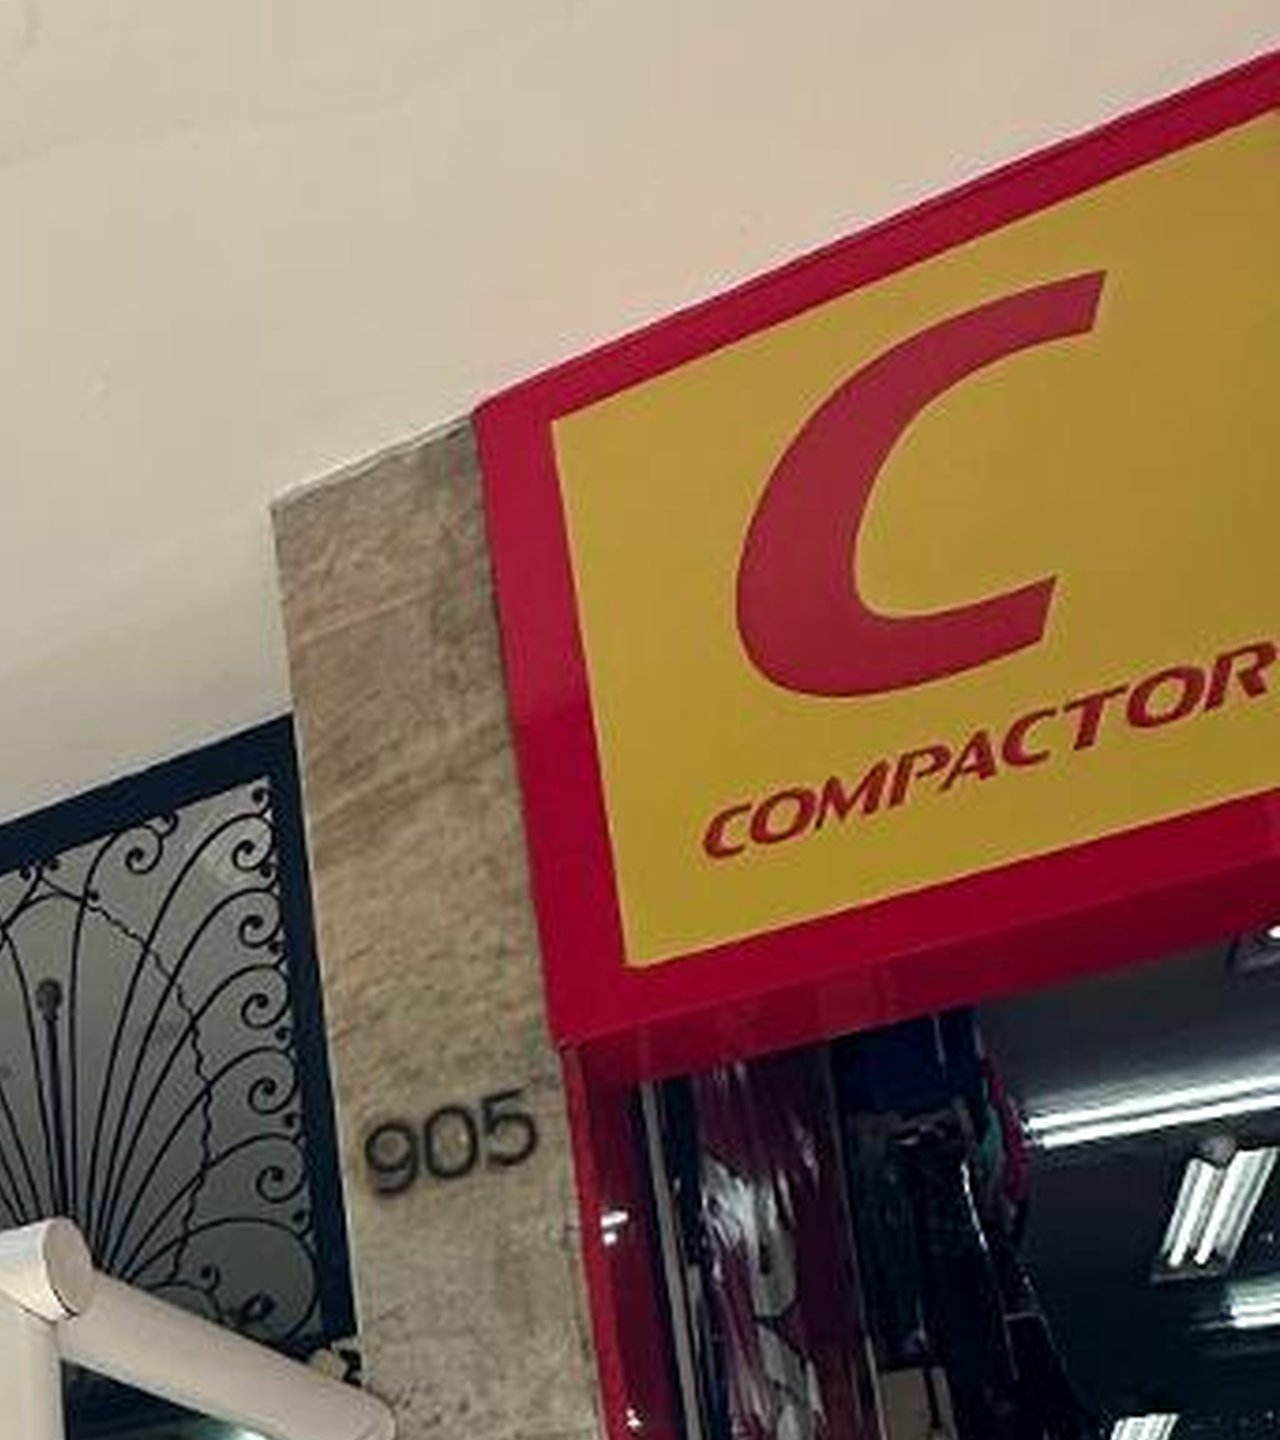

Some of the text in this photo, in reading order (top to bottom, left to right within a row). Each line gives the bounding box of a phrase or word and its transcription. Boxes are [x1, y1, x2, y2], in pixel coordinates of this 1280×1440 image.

[736, 269, 1107, 698] C
[702, 642, 1278, 859] COMPACTOR
[364, 1085, 537, 1197] 905
